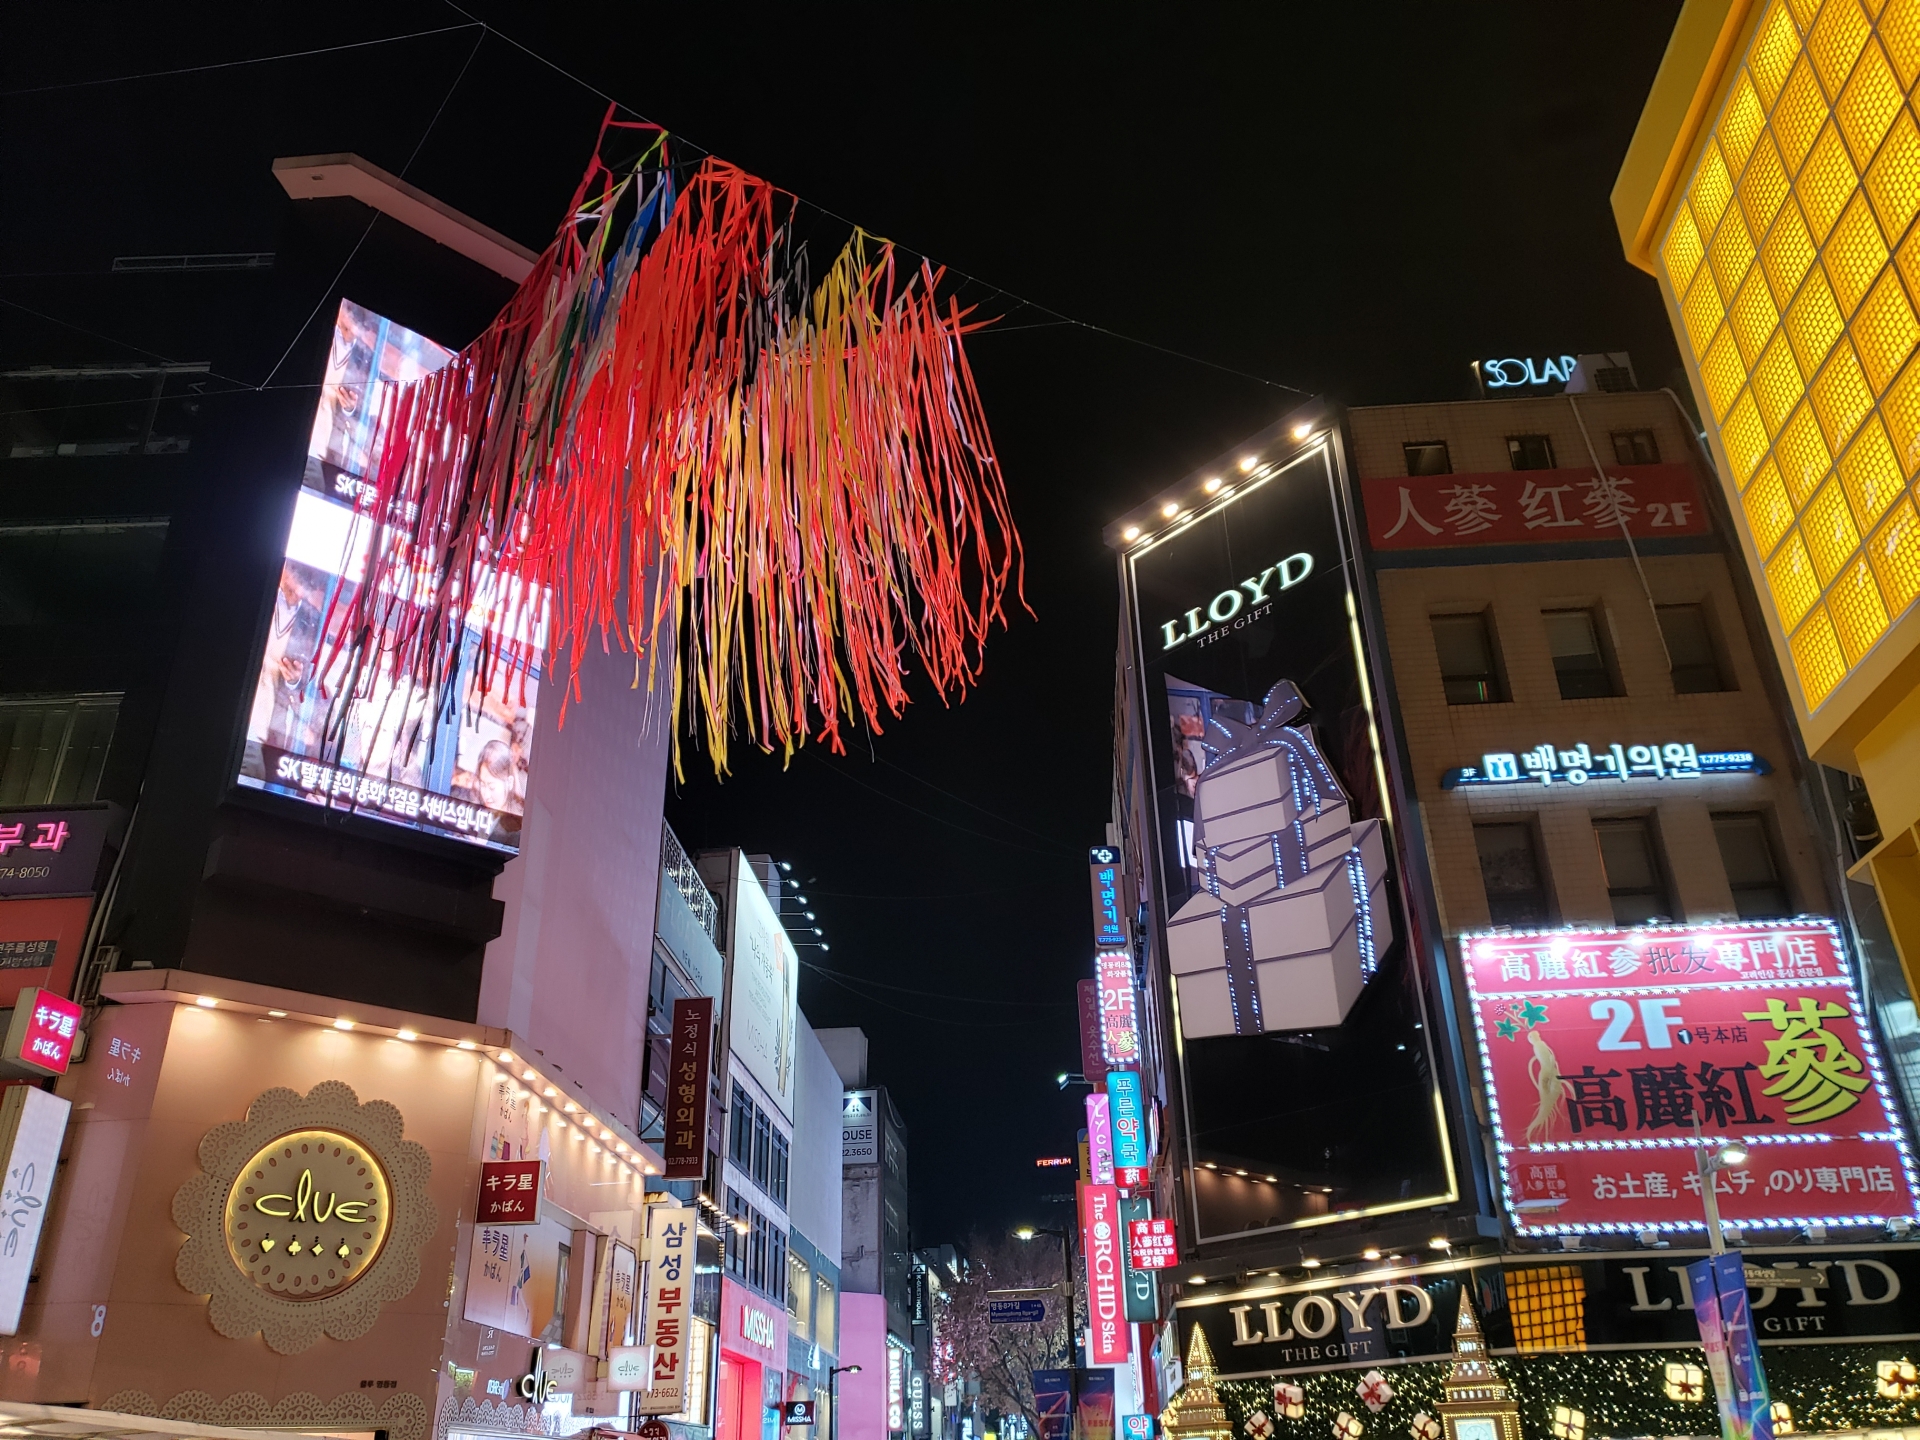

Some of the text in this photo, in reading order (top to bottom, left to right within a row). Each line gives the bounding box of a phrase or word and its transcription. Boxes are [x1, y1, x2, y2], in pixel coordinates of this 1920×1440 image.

[1646, 502, 1693, 527] 2F
[1161, 552, 1315, 650] LLOYD
[1197, 602, 1273, 648] THE GIFT
[1523, 743, 1701, 787] 백명기의원
[277, 756, 301, 781] SK
[420, 795, 494, 835] 서비스입니다
[1104, 989, 1132, 1011] 2F
[34, 1006, 74, 1038] キラ星
[1589, 998, 1684, 1052] 2F
[674, 1061, 698, 1150] 성형외과
[1116, 1077, 1139, 1162] 푸른약국
[1036, 1157, 1072, 1167] FERRUM
[485, 1173, 533, 1191] キラ星
[490, 1200, 525, 1213] かばん
[1093, 1193, 1107, 1220] The
[1100, 1322, 1116, 1355] Skin
[743, 1304, 775, 1351] MISSHA
[1229, 1284, 1433, 1346] LLOYD
[1763, 1315, 1826, 1333] GIFT
[1282, 1340, 1372, 1363] THE GIFT
[786, 1415, 812, 1423] MISSHA
[889, 1404, 901, 1429] CO
[912, 1376, 923, 1429] GUESS
[1128, 1416, 1149, 1440] 약
